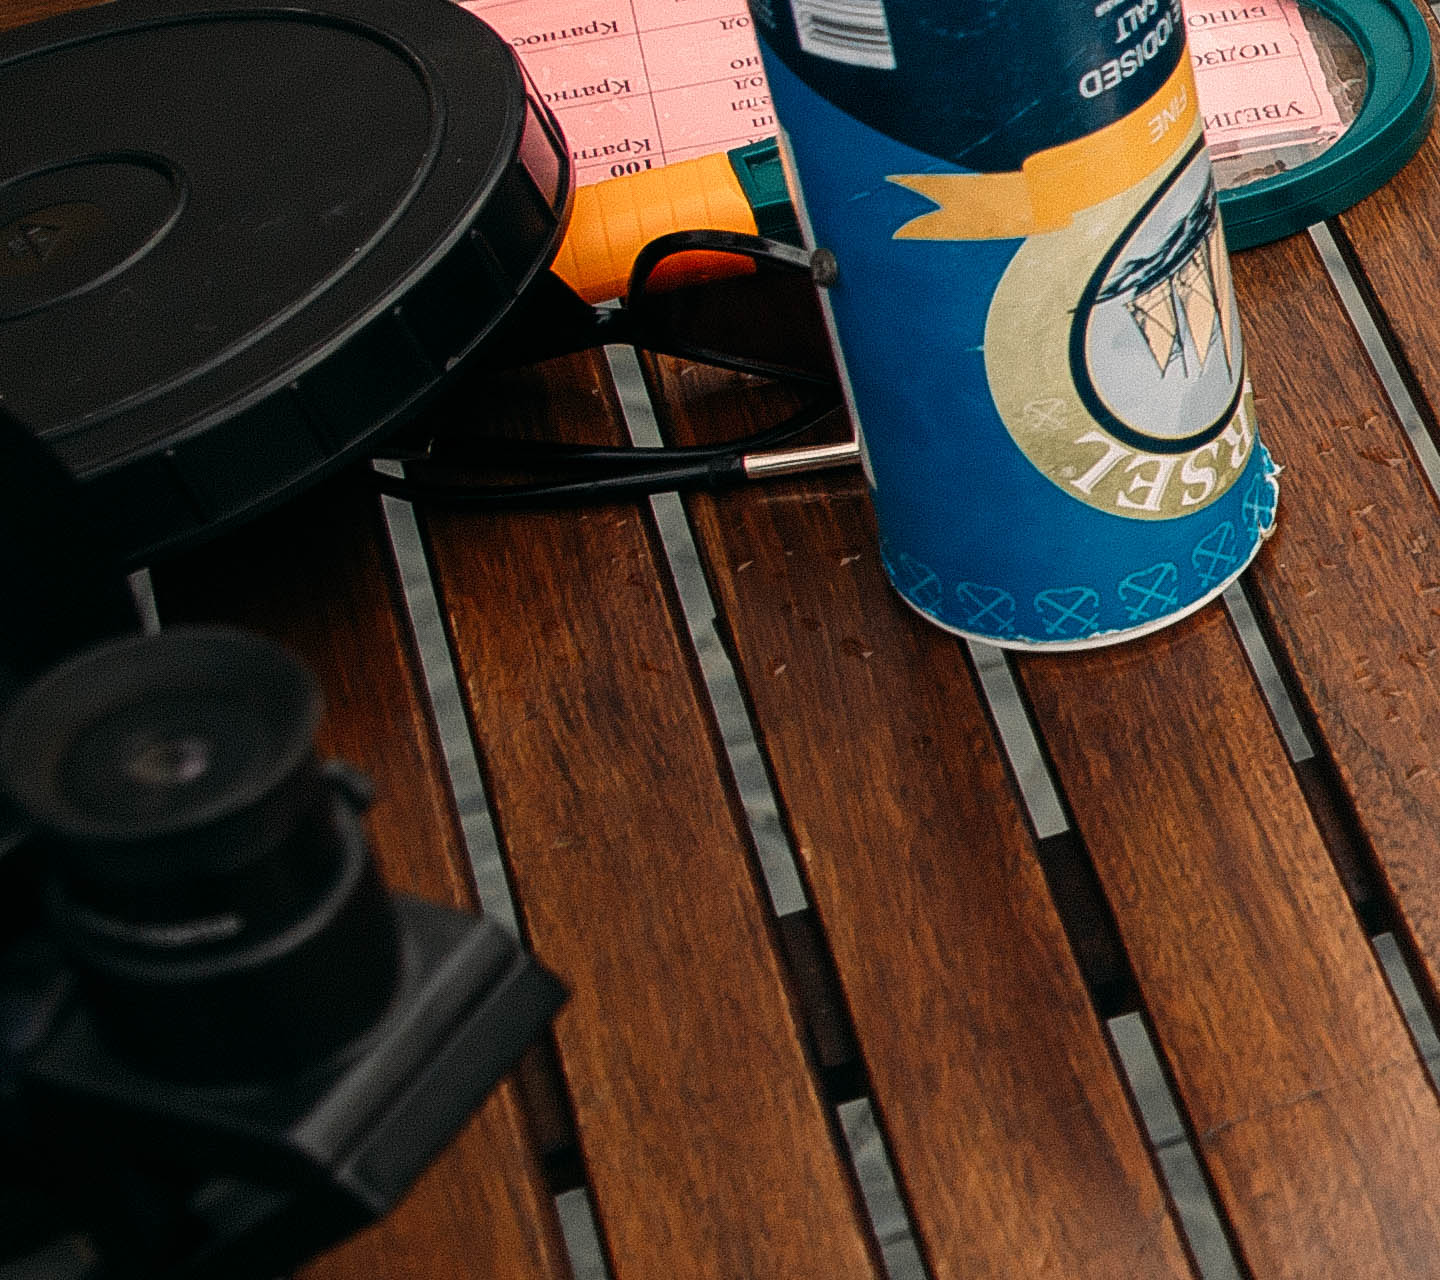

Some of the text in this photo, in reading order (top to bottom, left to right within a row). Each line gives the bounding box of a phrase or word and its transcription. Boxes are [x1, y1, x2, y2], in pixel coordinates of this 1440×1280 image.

[719, 16, 750, 31] од
[1187, 6, 1269, 27] БИНО
[512, 20, 620, 47] Кратнос
[1079, 9, 1174, 99] IODISED
[734, 76, 764, 91] од
[1148, 84, 1187, 144] FINE
[1203, 101, 1305, 131] УВЕЛИ
[572, 138, 651, 161] Кратн
[1070, 382, 1252, 511] RSEL
